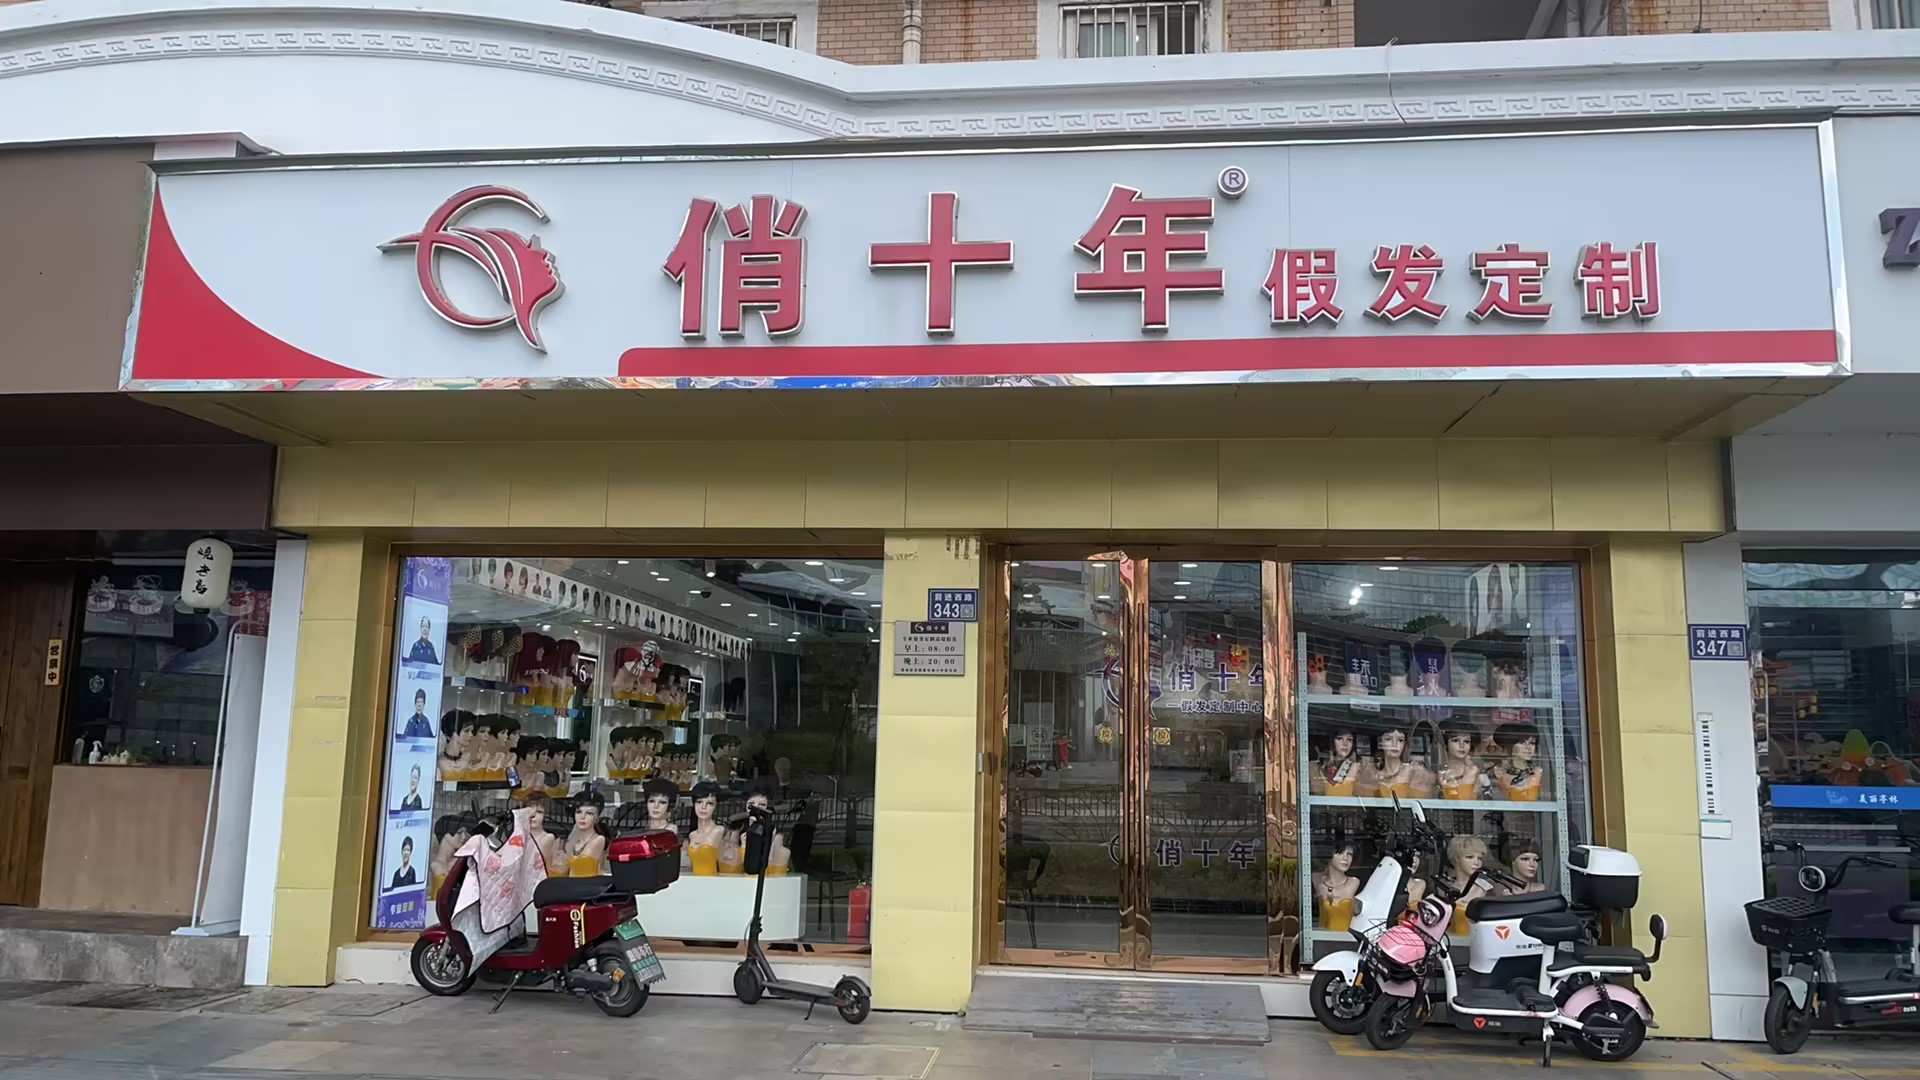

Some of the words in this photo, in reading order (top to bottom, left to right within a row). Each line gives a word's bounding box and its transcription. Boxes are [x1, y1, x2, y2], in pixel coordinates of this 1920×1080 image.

[661, 182, 1224, 341] 俏十年
[1261, 241, 1662, 326] 假发定制
[934, 592, 972, 602] 前进西路
[933, 602, 960, 618] 343
[1696, 629, 1740, 638] 前进西路
[1696, 639, 1727, 656] 347
[1154, 837, 1257, 870] 俏十年
